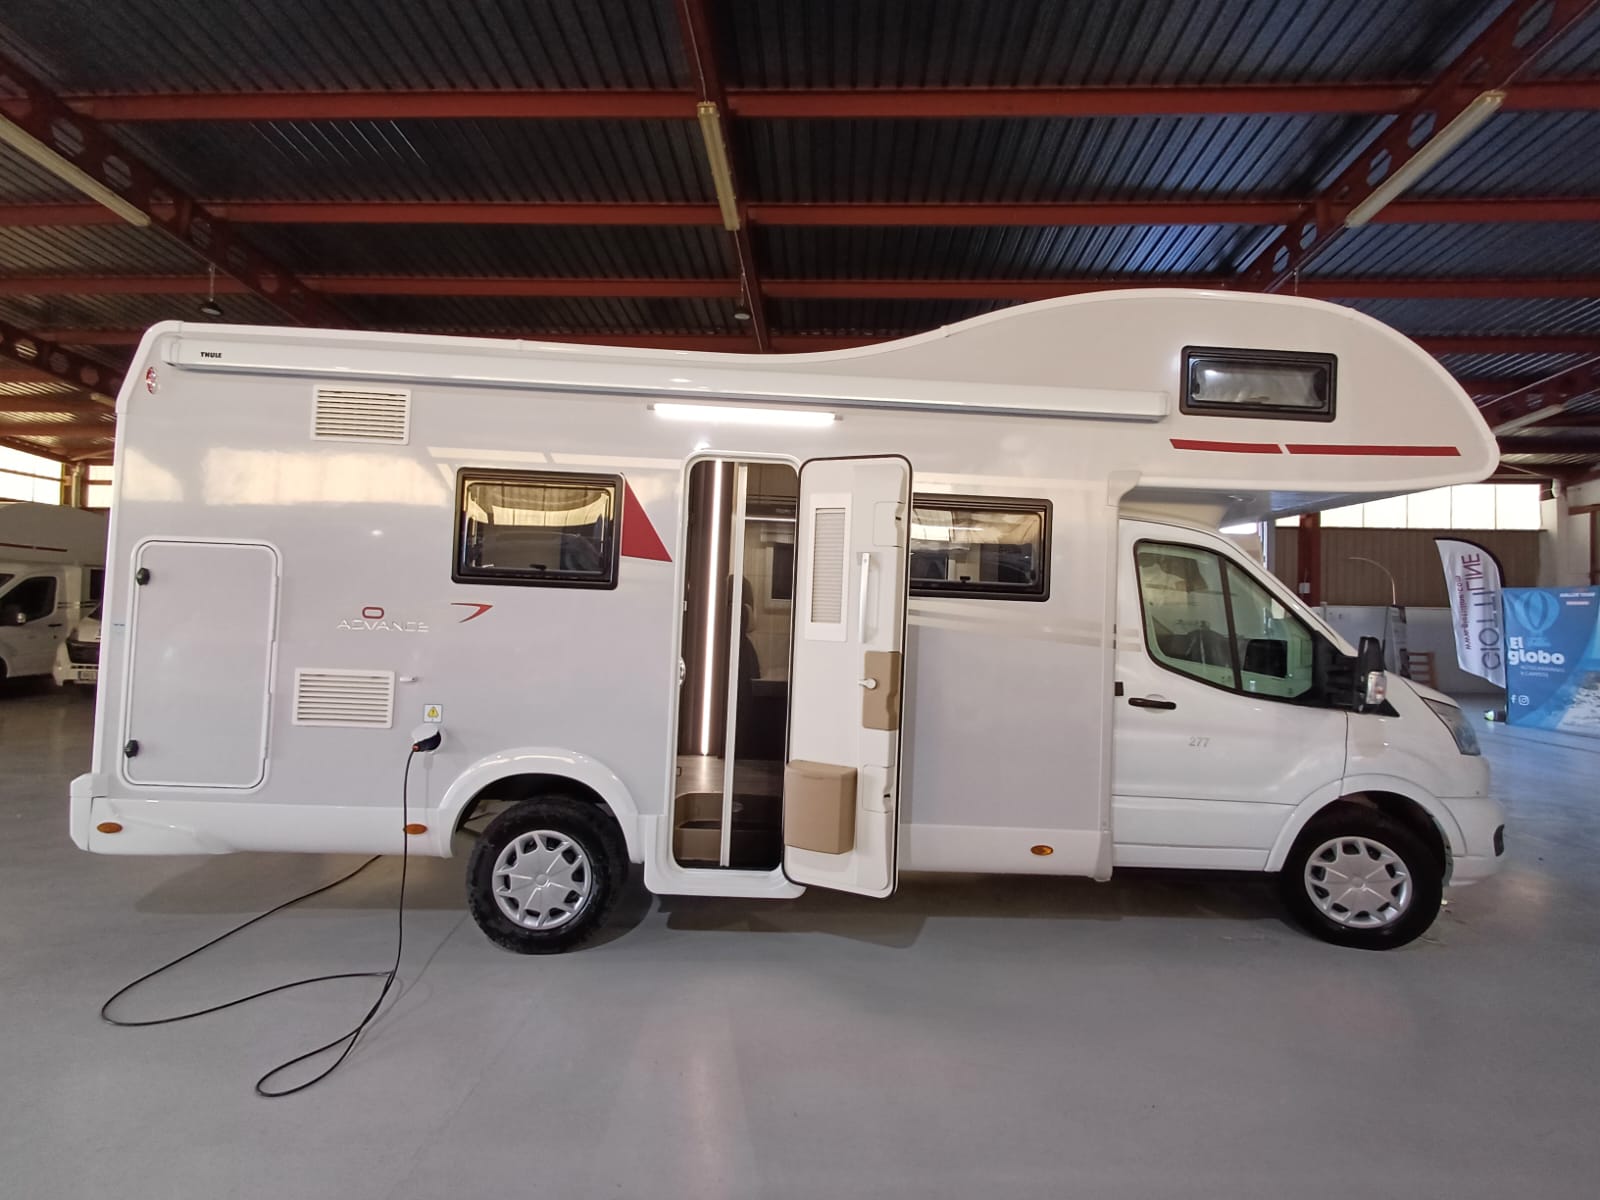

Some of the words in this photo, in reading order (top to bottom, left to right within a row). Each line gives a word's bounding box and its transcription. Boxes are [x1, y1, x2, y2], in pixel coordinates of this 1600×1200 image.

[200, 351, 222, 359] THULE
[336, 619, 430, 633] ADVANCE
[1507, 650, 1565, 666] globo
[1189, 736, 1210, 748] 277
